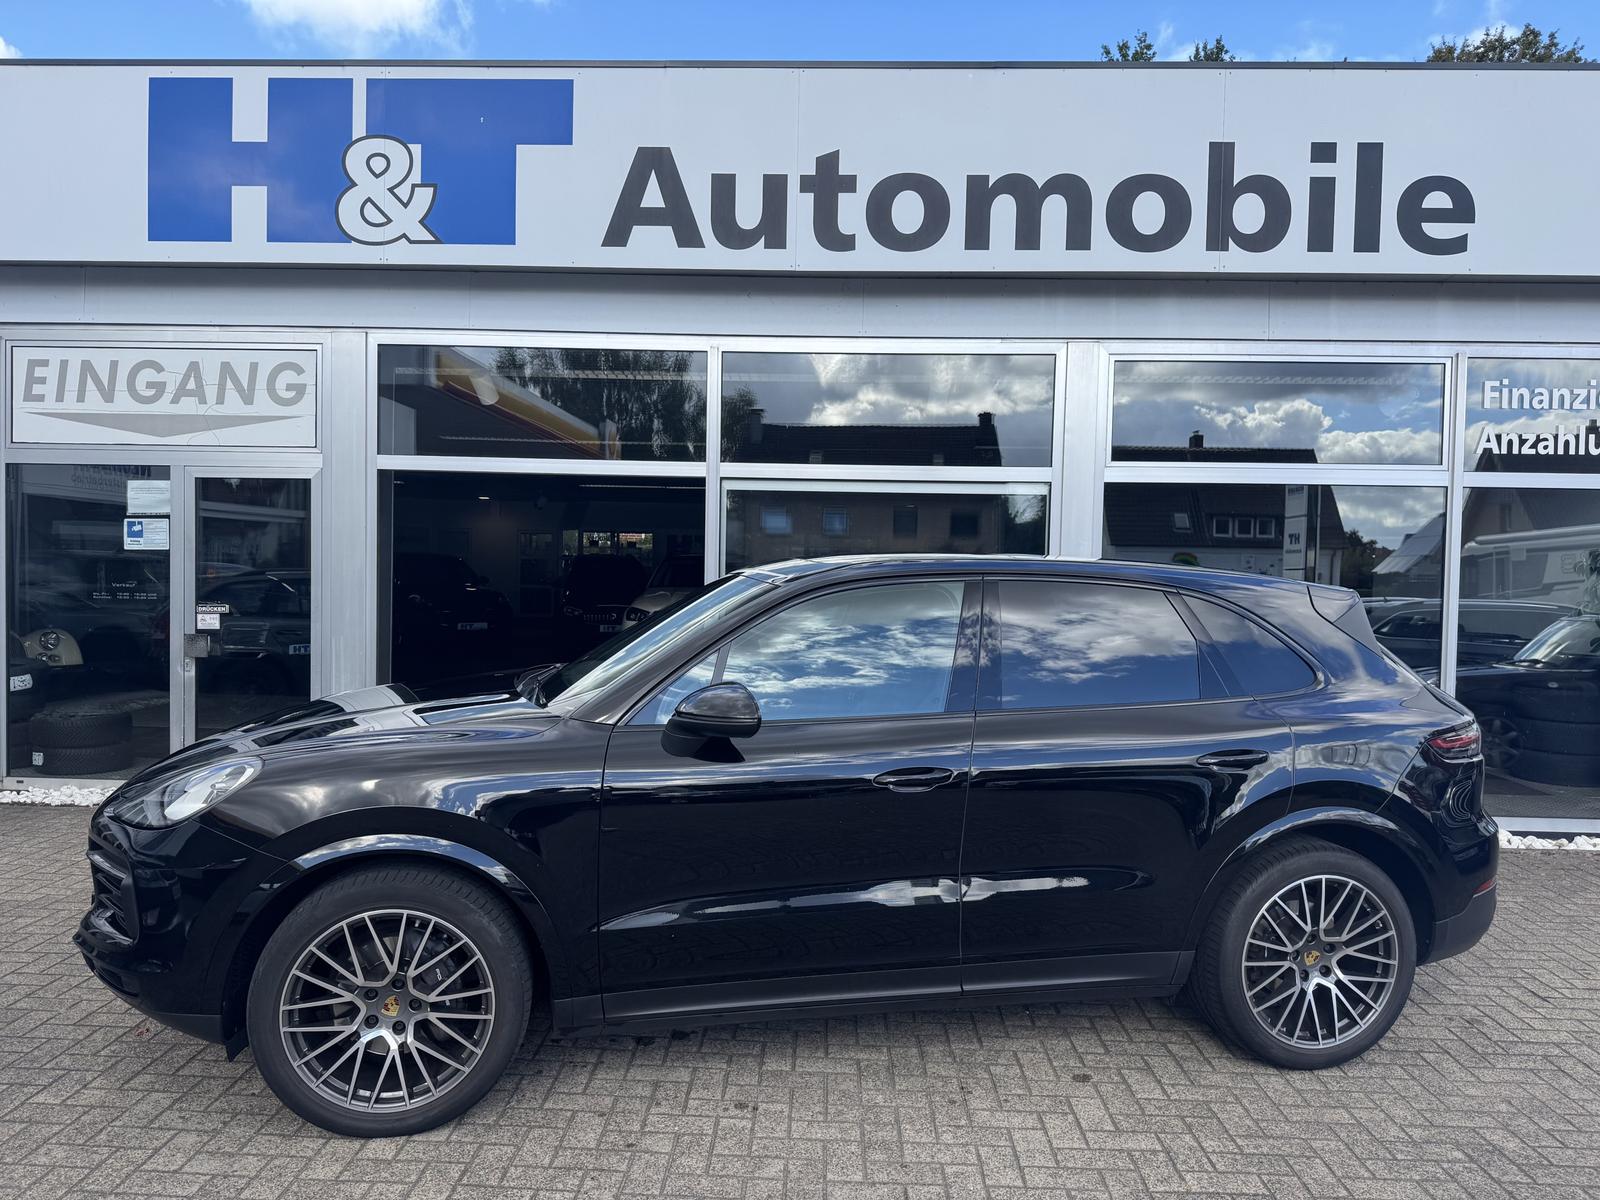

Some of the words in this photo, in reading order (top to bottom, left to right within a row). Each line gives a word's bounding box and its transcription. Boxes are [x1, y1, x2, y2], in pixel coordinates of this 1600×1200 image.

[148, 77, 574, 245] H&T
[601, 141, 1477, 256] Automobile
[22, 358, 308, 407] EINGANG
[1483, 378, 1600, 410] Finanzi
[198, 604, 226, 612] DRÜCKEN
